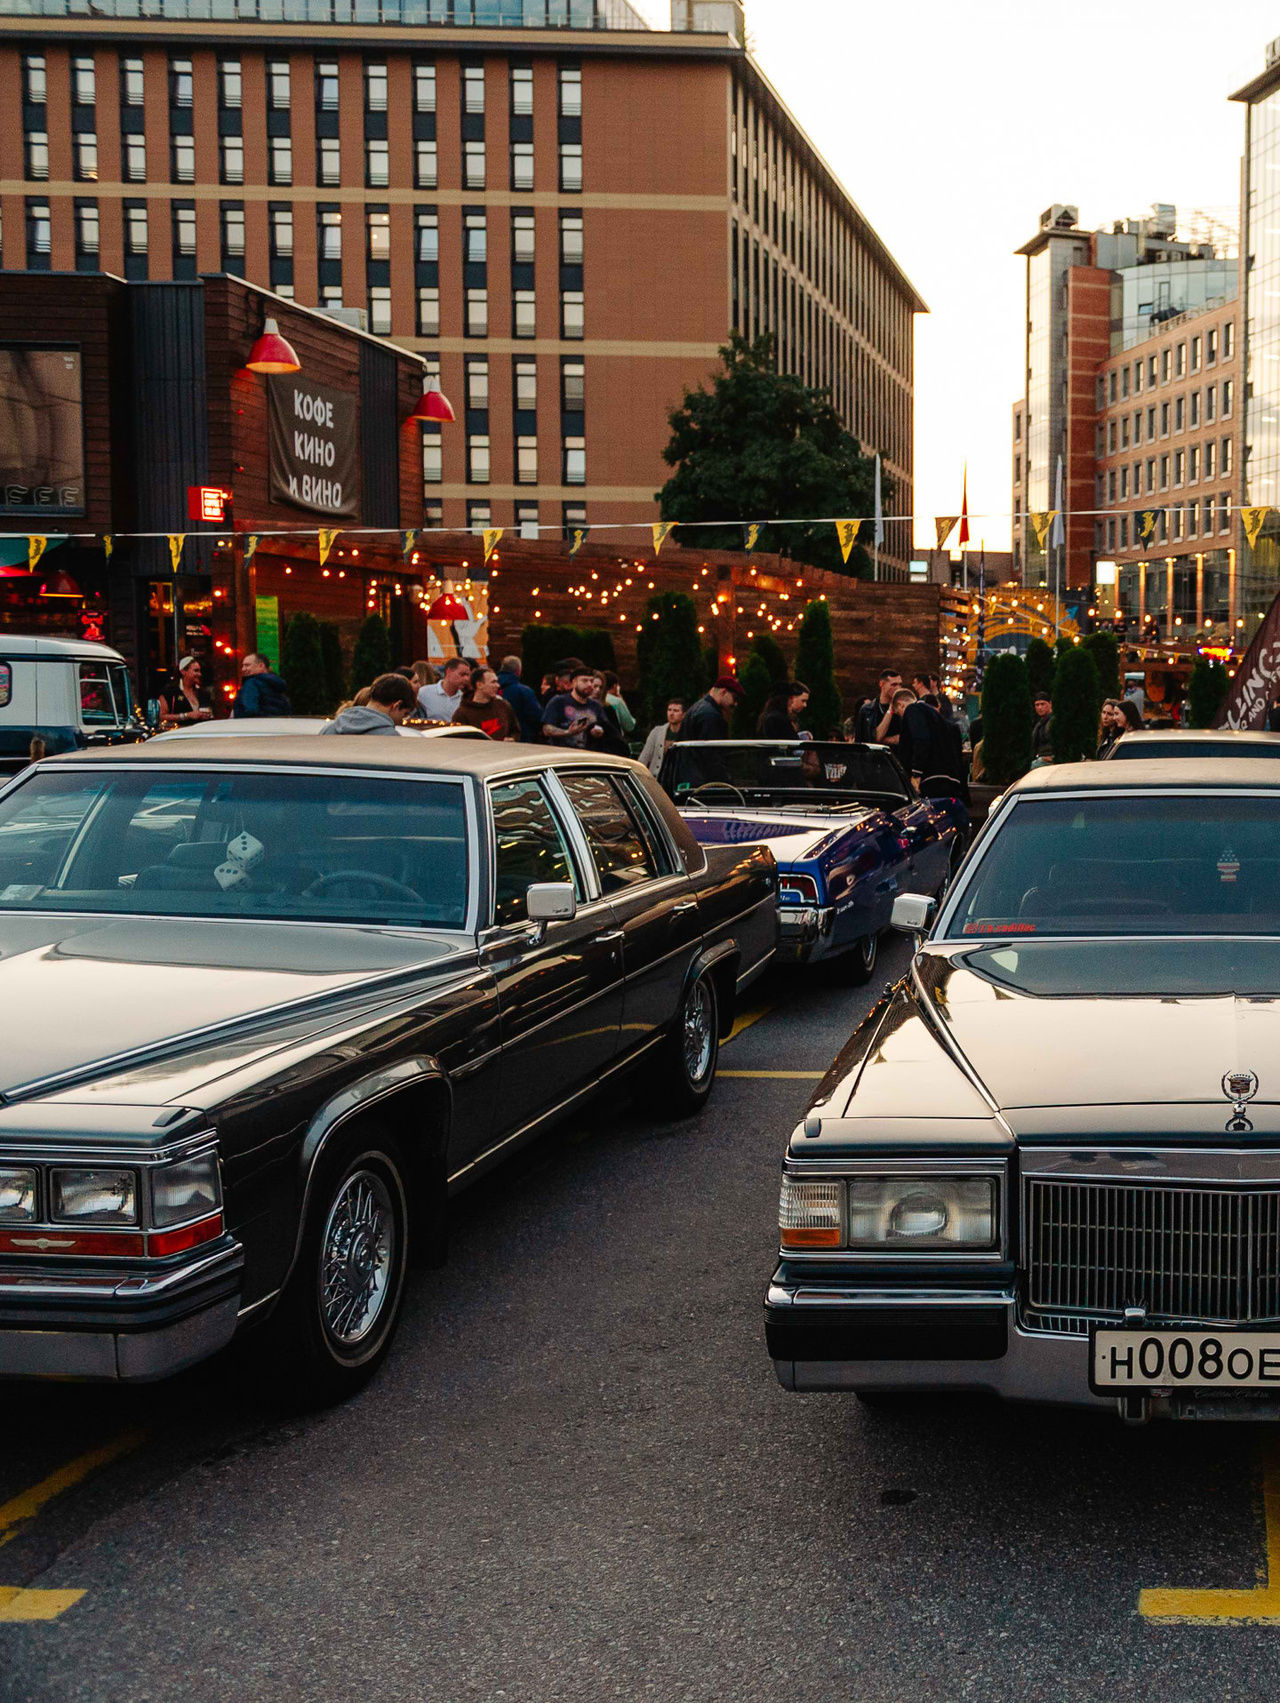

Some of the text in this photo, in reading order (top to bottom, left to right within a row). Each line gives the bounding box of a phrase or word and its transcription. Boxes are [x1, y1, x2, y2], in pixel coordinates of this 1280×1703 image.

[294, 389, 334, 429] КОФЕ
[294, 430, 335, 467] КИНО
[302, 474, 342, 508] ВИНО
